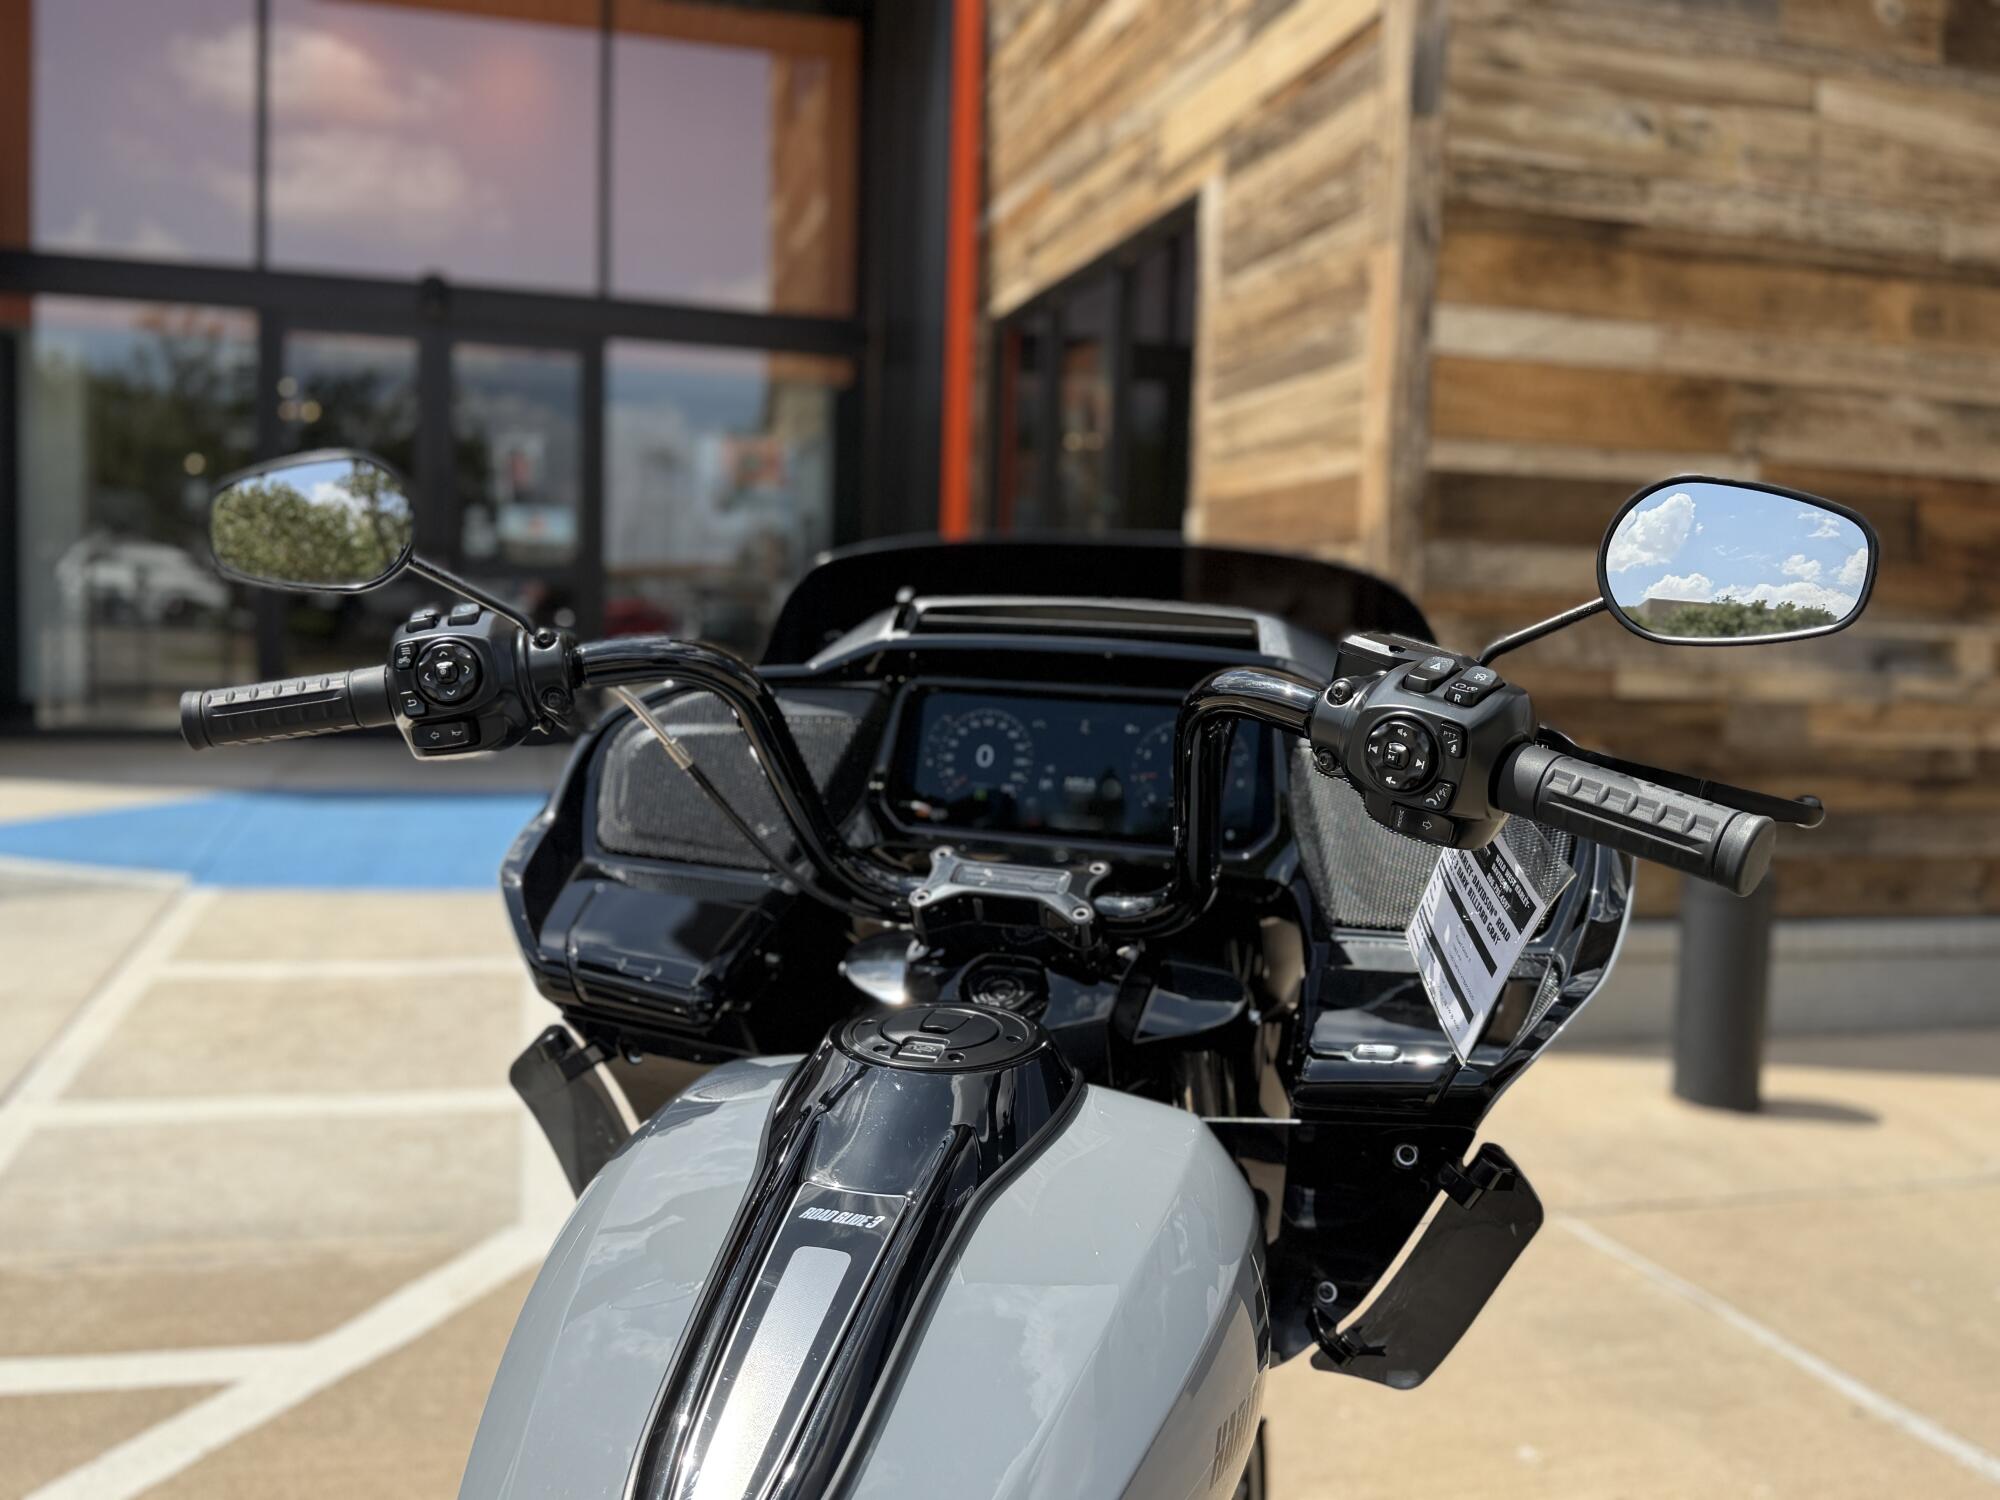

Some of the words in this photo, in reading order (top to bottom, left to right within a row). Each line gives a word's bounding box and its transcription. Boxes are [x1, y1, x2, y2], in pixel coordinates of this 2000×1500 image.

[1454, 693, 1462, 703] R
[975, 744, 995, 768] 0
[1456, 866, 1470, 891] DARK
[1466, 886, 1488, 925] BILLIARD
[1486, 921, 1501, 947] GRAY
[1495, 916, 1511, 943] ROAD
[798, 1206, 840, 1221] ROAD
[832, 1211, 875, 1227] GLIDE
[865, 1215, 886, 1229] 3
